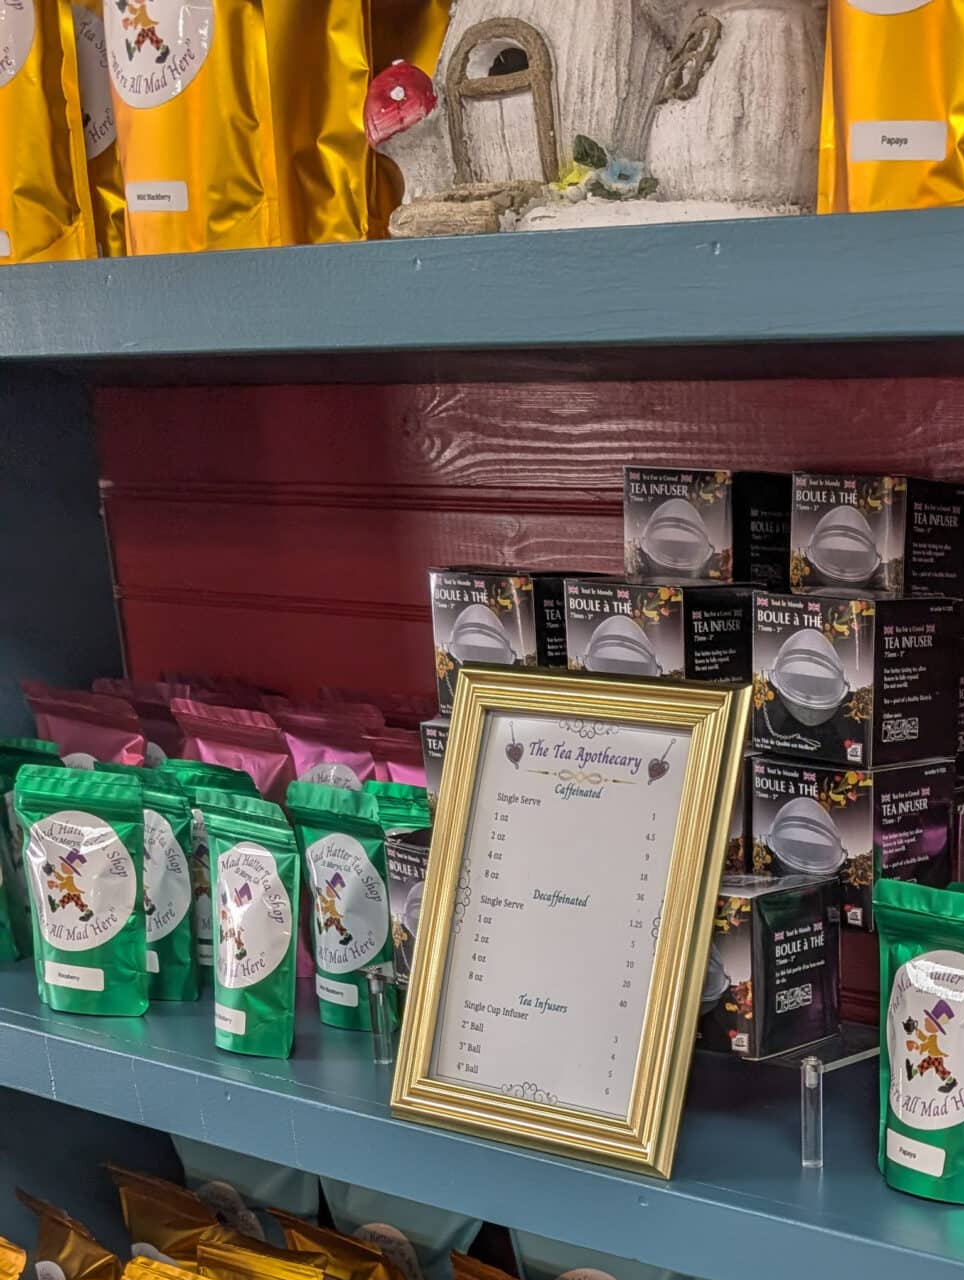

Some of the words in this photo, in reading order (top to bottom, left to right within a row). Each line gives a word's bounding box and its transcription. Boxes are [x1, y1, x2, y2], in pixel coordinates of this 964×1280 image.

[129, 76, 141, 94] All
[145, 72, 168, 95] Mad
[881, 135, 908, 147] Papaya
[630, 482, 647, 494] TEA
[650, 482, 688, 496] INFUSER
[796, 490, 827, 503] BOULE
[839, 491, 858, 505] THÉ
[569, 598, 600, 611] BOULE
[613, 600, 633, 615] THÉ
[757, 609, 790, 625] BOULE
[794, 612, 800, 626] à
[803, 613, 823, 628] THÉ
[693, 621, 708, 633] TEA
[710, 621, 741, 632] INFUSER
[885, 636, 900, 649] TEA
[902, 635, 933, 648] INFUSER
[529, 740, 548, 758] The
[553, 741, 572, 760] Tea
[575, 747, 643, 775] Apothecary
[554, 783, 604, 800] Caffeinated
[755, 777, 786, 792] BOULE
[789, 780, 795, 793] à
[798, 781, 818, 797] THÉ
[497, 792, 519, 805] Single
[520, 795, 541, 806] Serve
[882, 803, 896, 816] TEA
[899, 799, 928, 814] INFUSER
[500, 814, 509, 822] oz
[497, 833, 506, 841] oz
[107, 848, 129, 878] Shop
[493, 852, 502, 860] oz
[326, 844, 352, 862] Hatter
[351, 857, 363, 876] Tea
[361, 875, 383, 902] Shop
[490, 872, 499, 880] oz
[480, 895, 502, 908] Single
[504, 899, 525, 911] Serve
[533, 889, 591, 908] Decaffeinated
[483, 916, 493, 925] oz
[480, 936, 489, 944] oz
[775, 940, 801, 957] BOULE
[810, 932, 824, 949] THÉ
[477, 955, 487, 963] oz
[474, 973, 484, 982] oz
[464, 1000, 486, 1013] Single
[487, 1004, 501, 1016] Cup
[502, 1007, 529, 1020] Infuser
[518, 993, 532, 1008] Tea
[534, 997, 568, 1014] Infusers
[470, 1022, 484, 1033] Ball
[467, 1043, 481, 1054] Ball
[465, 1064, 479, 1074] Ball
[899, 1146, 917, 1159] Papaya
